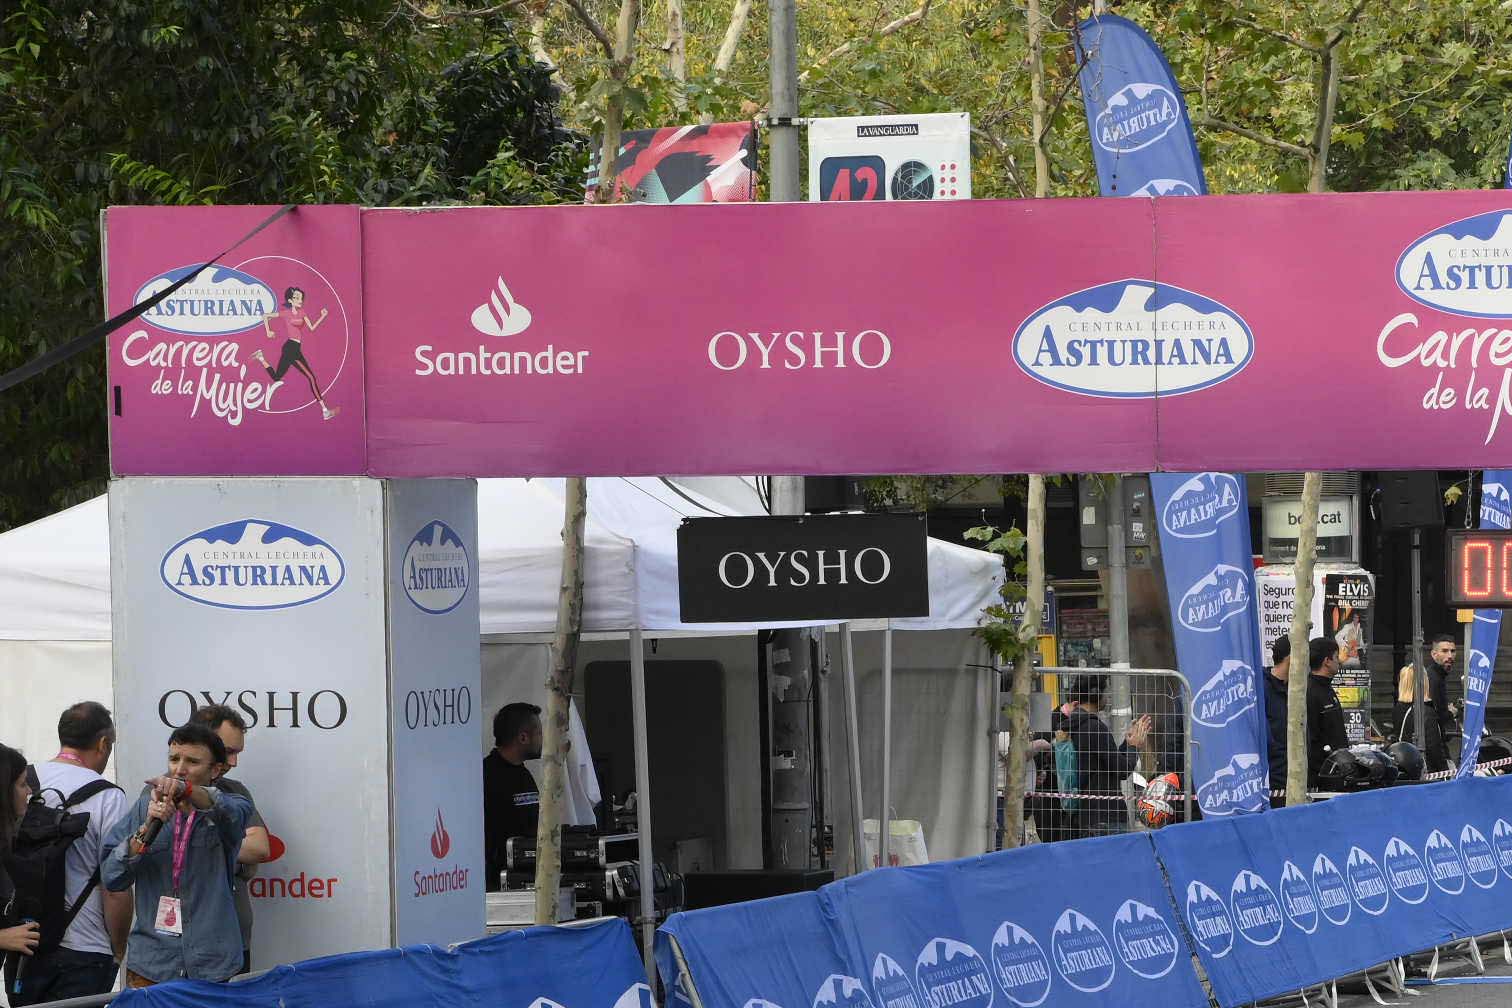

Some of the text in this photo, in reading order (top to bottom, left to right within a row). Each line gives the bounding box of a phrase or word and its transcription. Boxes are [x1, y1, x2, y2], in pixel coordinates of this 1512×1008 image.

[858, 125, 918, 136] LA VANGUARDIA
[146, 290, 265, 316] ASTURIANA
[172, 288, 211, 296] ENTRAL
[1068, 318, 1229, 333] CENTRAL LECHERA
[122, 329, 240, 368] Carrera
[415, 344, 590, 377] Santander
[707, 329, 892, 371] OYSHO
[1032, 324, 1235, 368] ASTURIANA
[151, 364, 284, 426] de la Mujer
[1422, 372, 1457, 411] de
[1464, 368, 1490, 411] la
[175, 554, 331, 587] ASTURIANA
[203, 550, 326, 560] CENTRAL LECHERA
[718, 547, 891, 589] OYSHO
[408, 556, 466, 591] ASTURIANA
[1338, 583, 1369, 596] ELVIS
[1263, 600, 1280, 612] que
[1264, 611, 1296, 624] quiere
[405, 686, 471, 731] OYSHO
[1349, 713, 1362, 724] 30
[249, 875, 338, 899] ander
[413, 866, 469, 898] Santander
